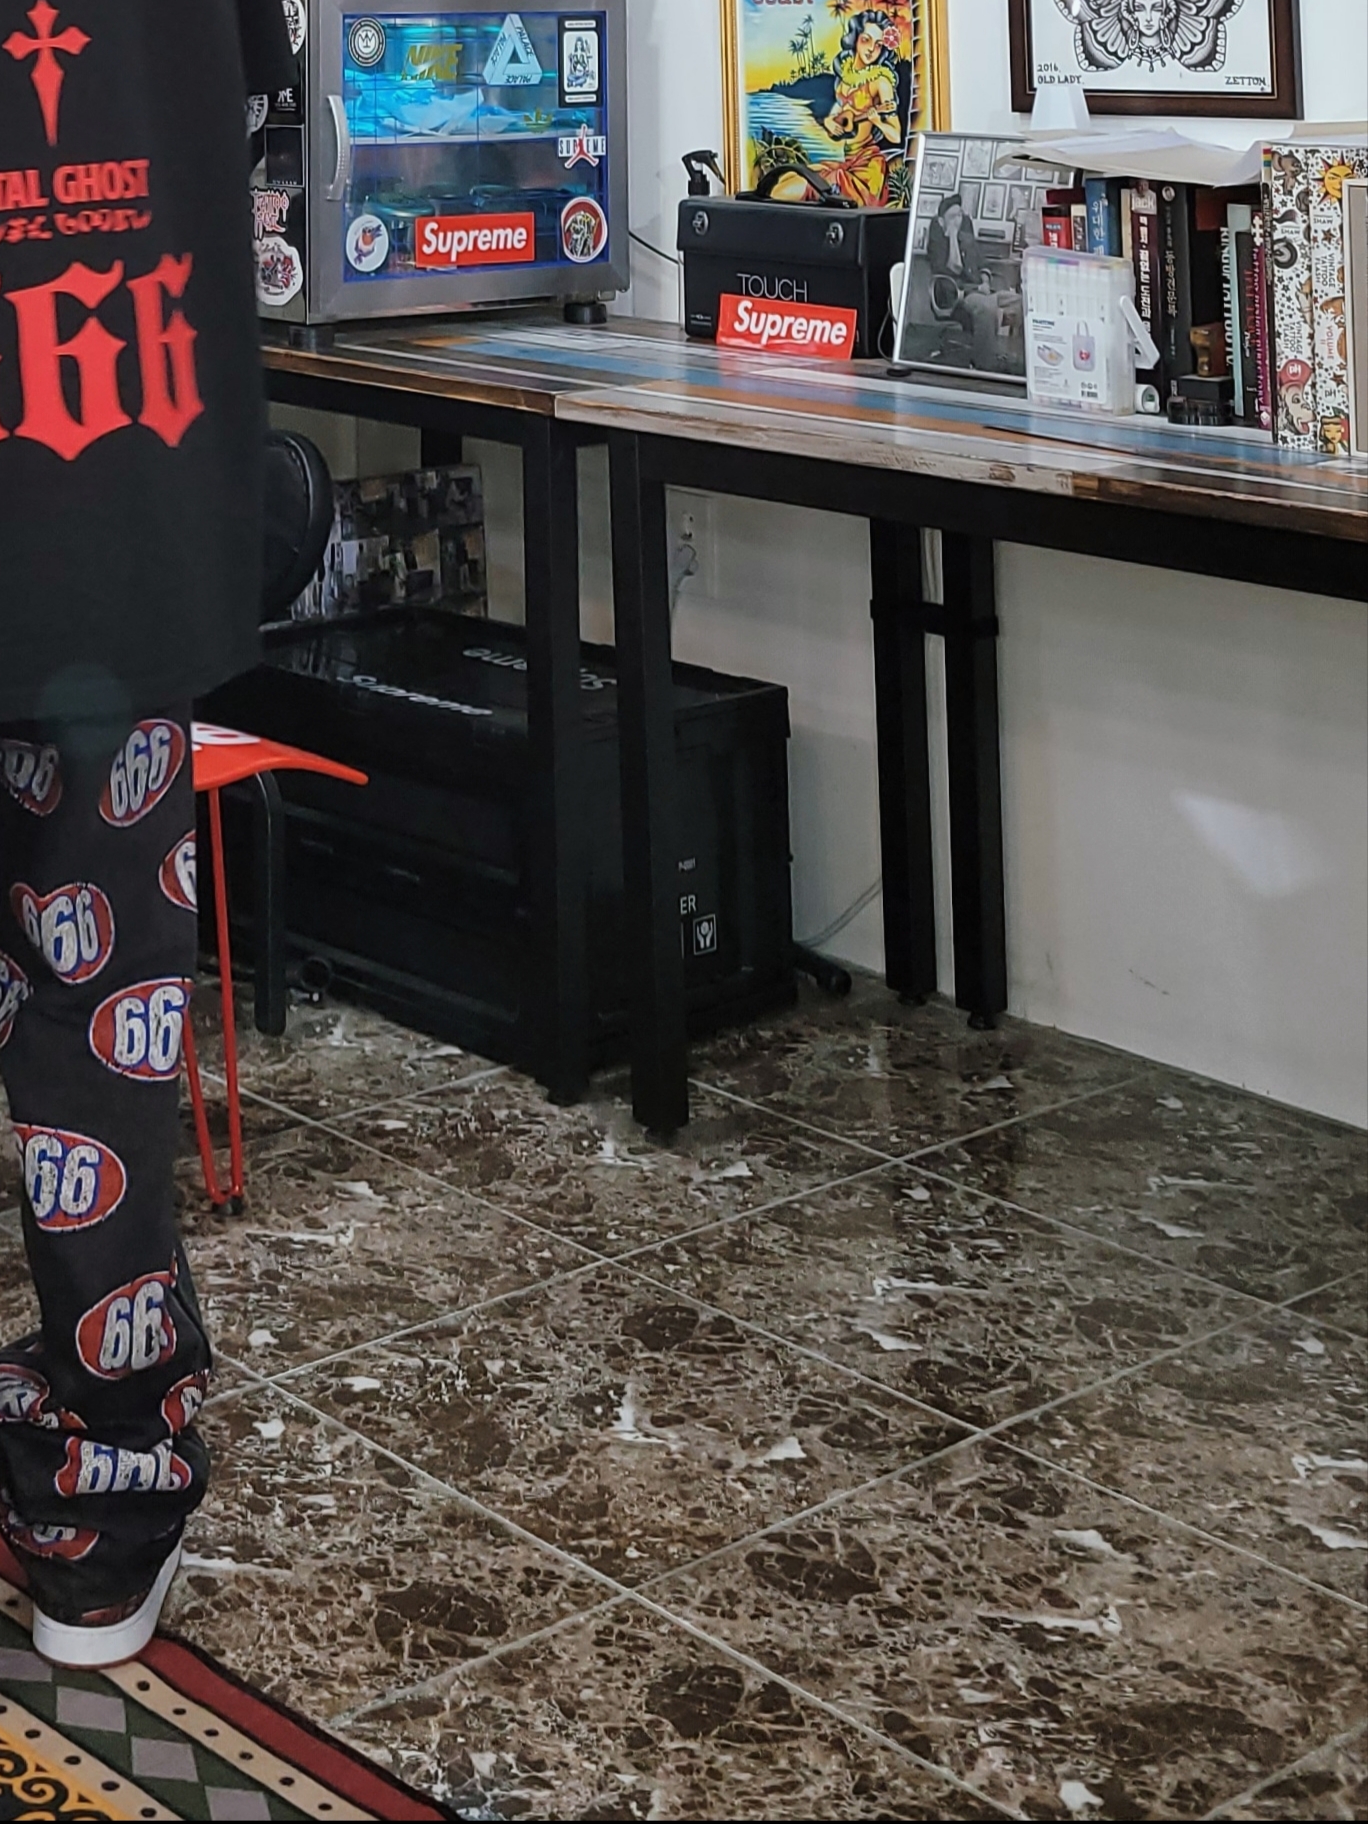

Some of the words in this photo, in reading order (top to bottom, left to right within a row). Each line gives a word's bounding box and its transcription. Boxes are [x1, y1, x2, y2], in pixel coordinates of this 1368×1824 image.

[490, 32, 507, 67] PALACE
[516, 26, 534, 58] PALACE
[1037, 75, 1055, 85] OLD
[53, 159, 150, 205] GHOST
[422, 221, 527, 262] Supreme
[736, 273, 808, 302] TOUCH
[734, 300, 847, 346] Supreme
[109, 724, 171, 819] 666
